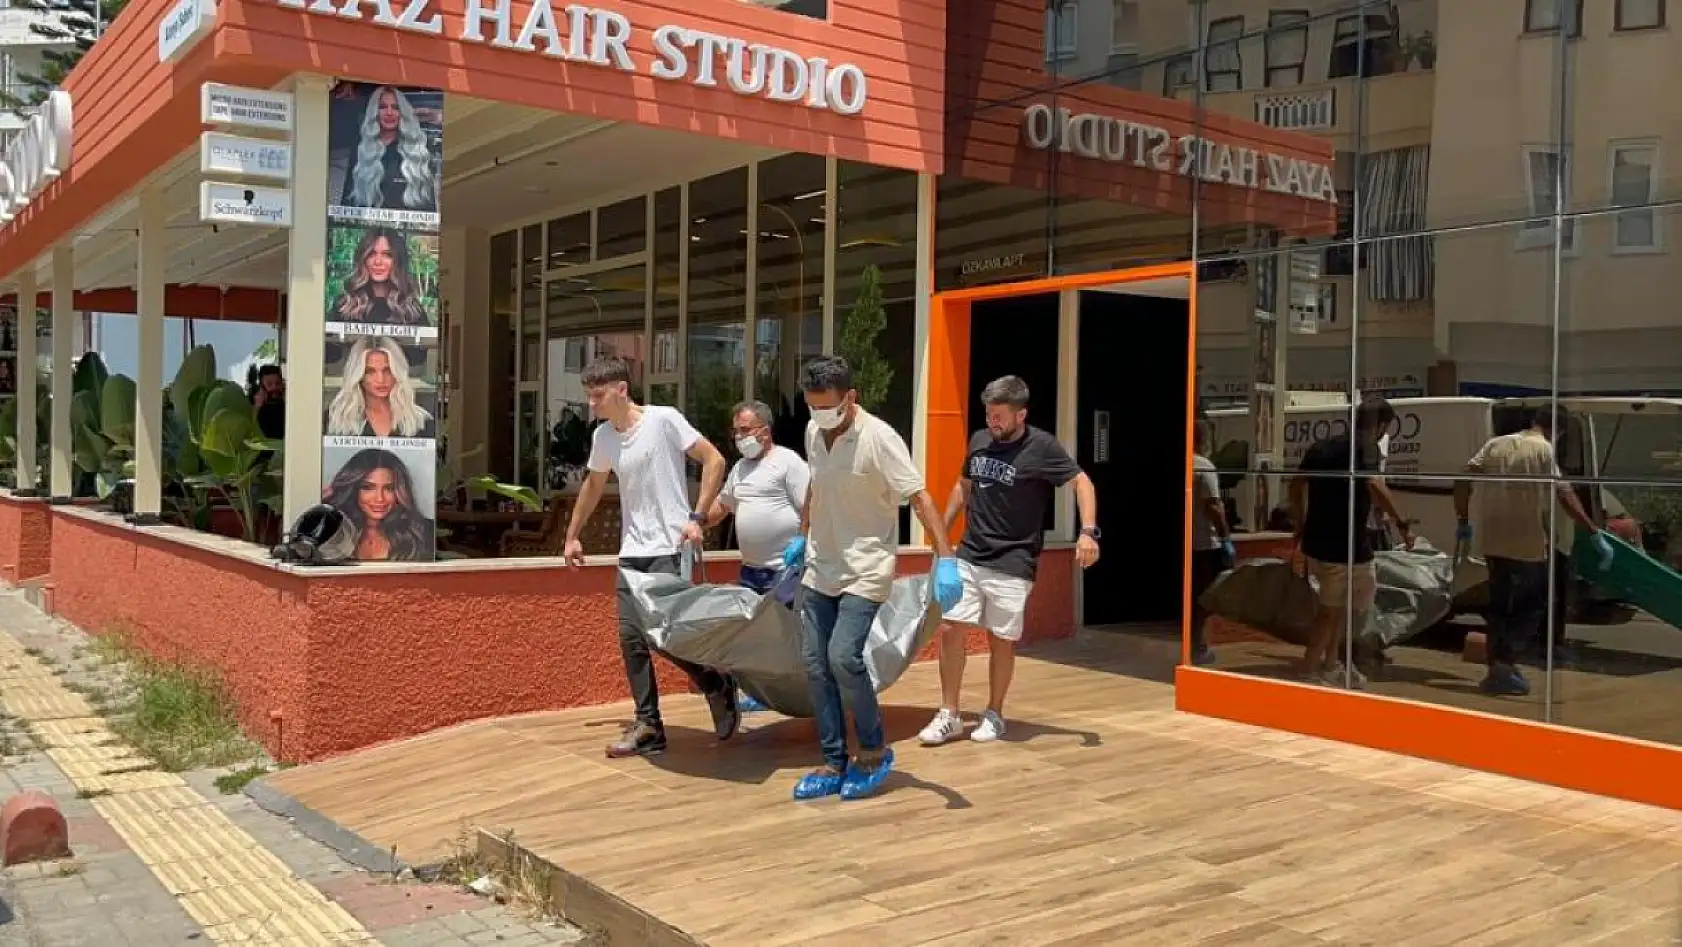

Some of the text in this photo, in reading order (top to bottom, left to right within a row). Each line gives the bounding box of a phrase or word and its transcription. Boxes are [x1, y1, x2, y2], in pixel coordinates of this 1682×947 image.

[460, 0, 635, 72] HAIR
[651, 24, 867, 115] STUDIO
[213, 203, 284, 221] Schwarzkopf
